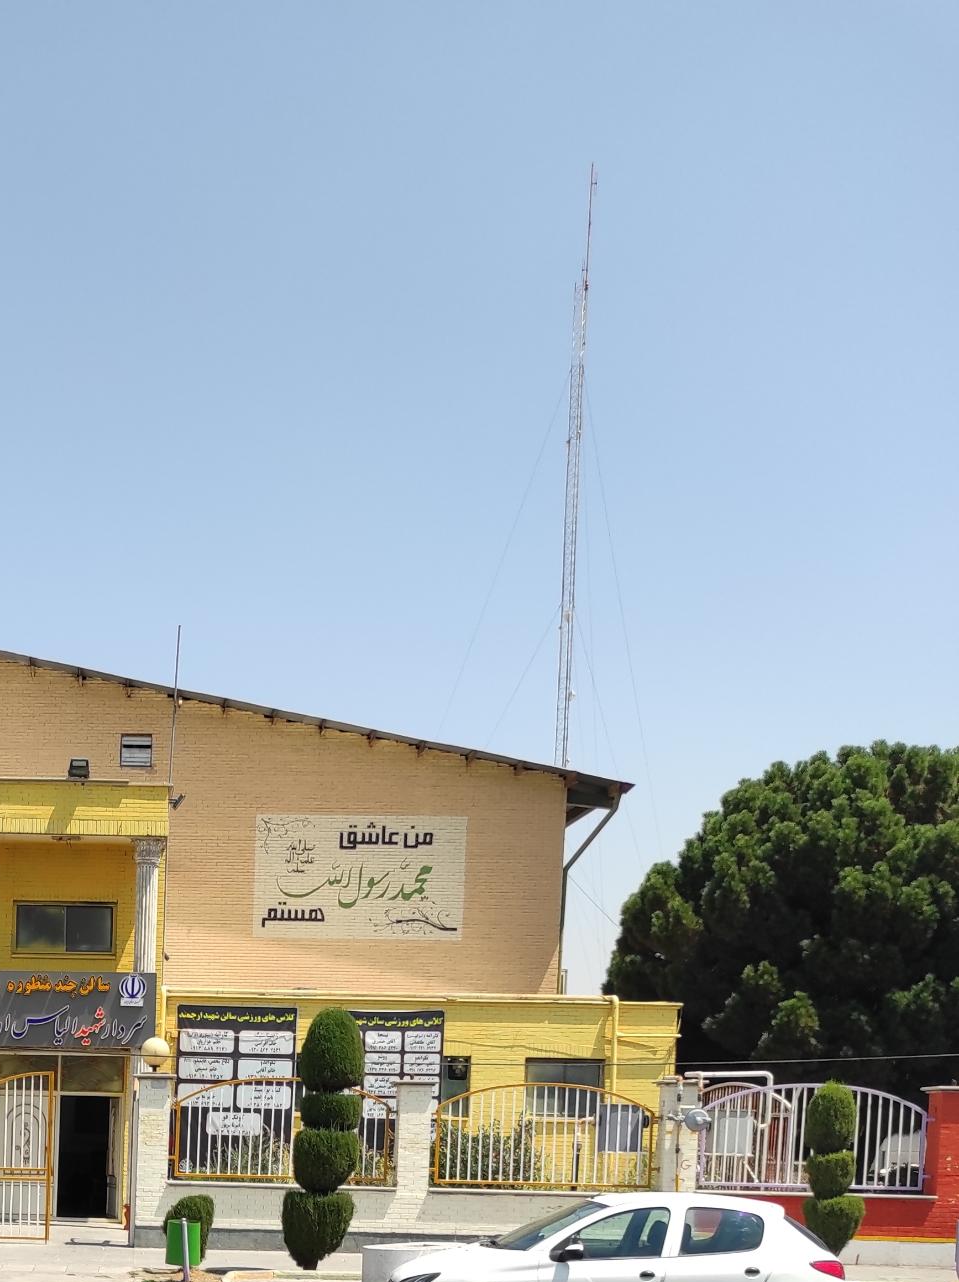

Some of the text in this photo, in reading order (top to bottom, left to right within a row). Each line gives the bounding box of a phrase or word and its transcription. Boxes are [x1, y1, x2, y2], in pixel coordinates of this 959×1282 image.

[339, 822, 433, 849] من عاشق
[261, 902, 324, 927] هستم
[7, 975, 111, 998] سالن چند منظوره
[10, 1005, 78, 1045] الیاس
[74, 1006, 106, 1045] شهید
[101, 1014, 147, 1044] سردار
[179, 1011, 295, 1023] کلاس های ورزشی سالن شهید ارجمند
[355, 1016, 443, 1027] کلاس های ورزشی سالن شهی
